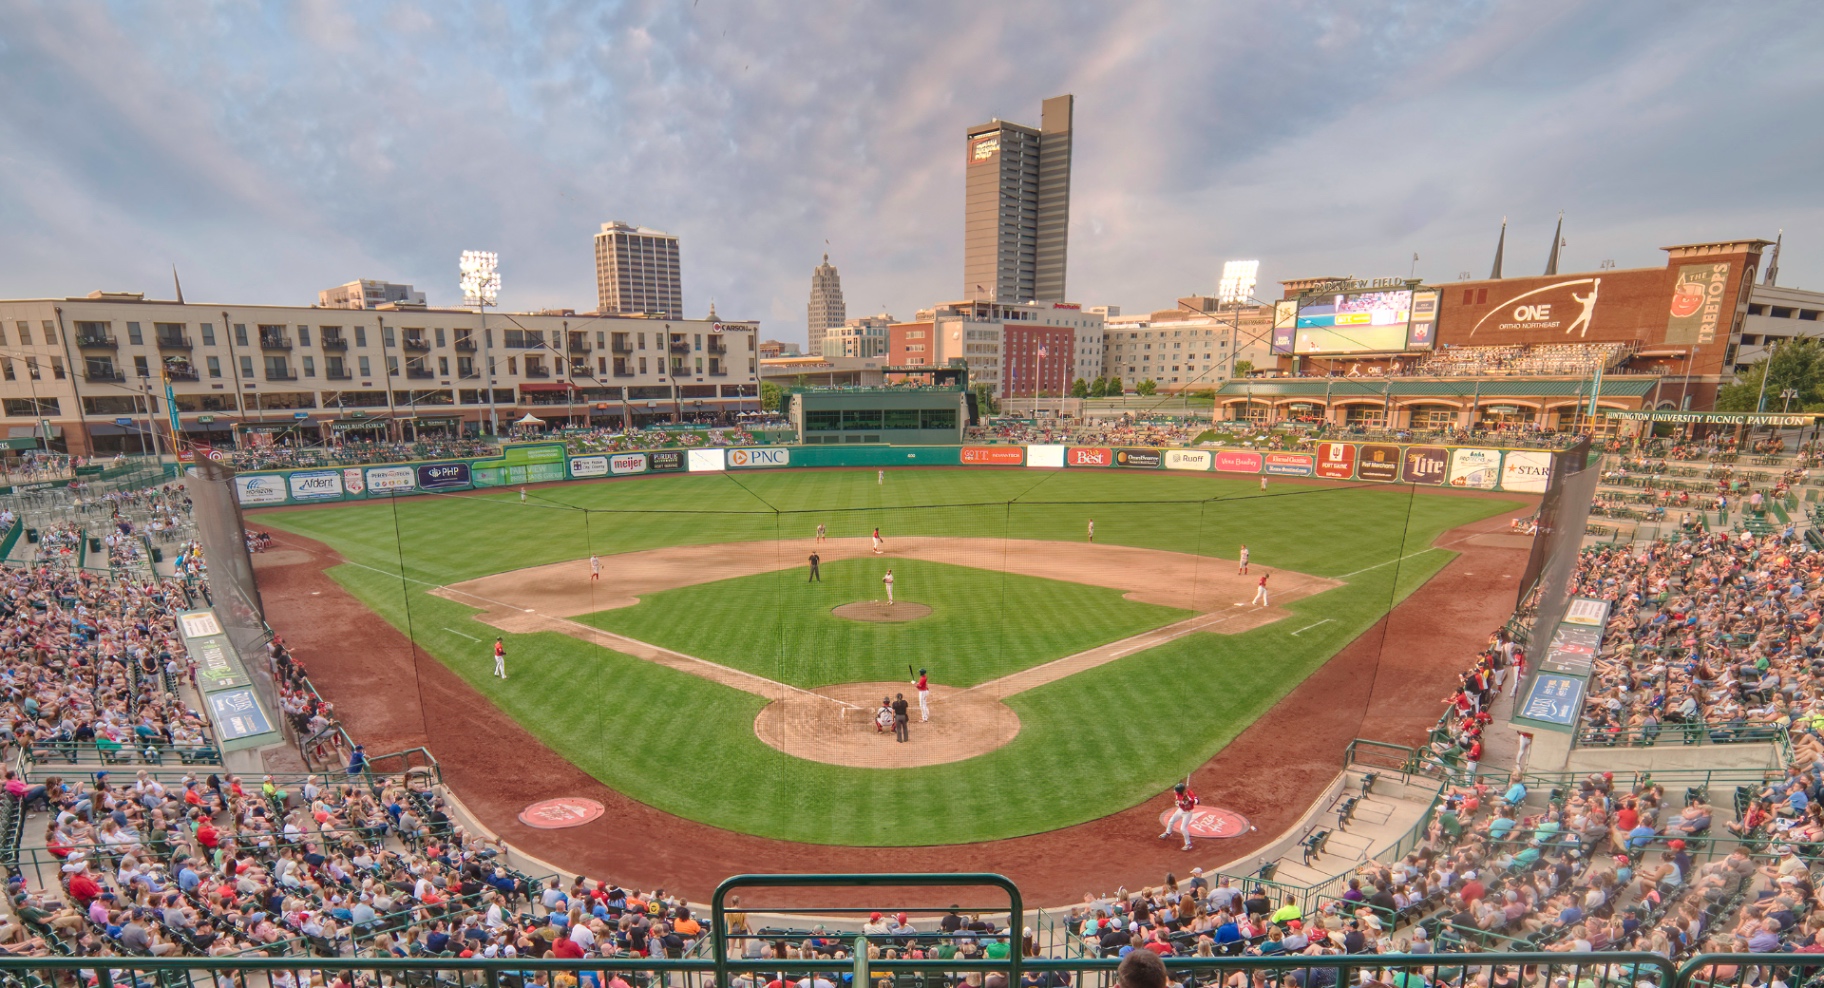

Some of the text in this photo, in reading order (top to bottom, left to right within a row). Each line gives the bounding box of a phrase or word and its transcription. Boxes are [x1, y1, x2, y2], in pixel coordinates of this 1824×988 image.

[1372, 277, 1402, 287] FIELD
[1690, 272, 1707, 281] THE
[1698, 263, 1728, 343] TREETOPS
[1514, 304, 1551, 321] ONE
[1522, 321, 1560, 329] NORTHEAST
[1606, 411, 1805, 426] HUNTINGTON UNIVERSITY PICNIC PAVILION
[751, 450, 784, 463] PNC
[1077, 451, 1103, 464] Best
[1182, 455, 1204, 463] Ruoff
[614, 457, 642, 469] meijer
[1411, 454, 1443, 477] Lite
[441, 467, 459, 476] PHP
[1518, 465, 1550, 475] STAR
